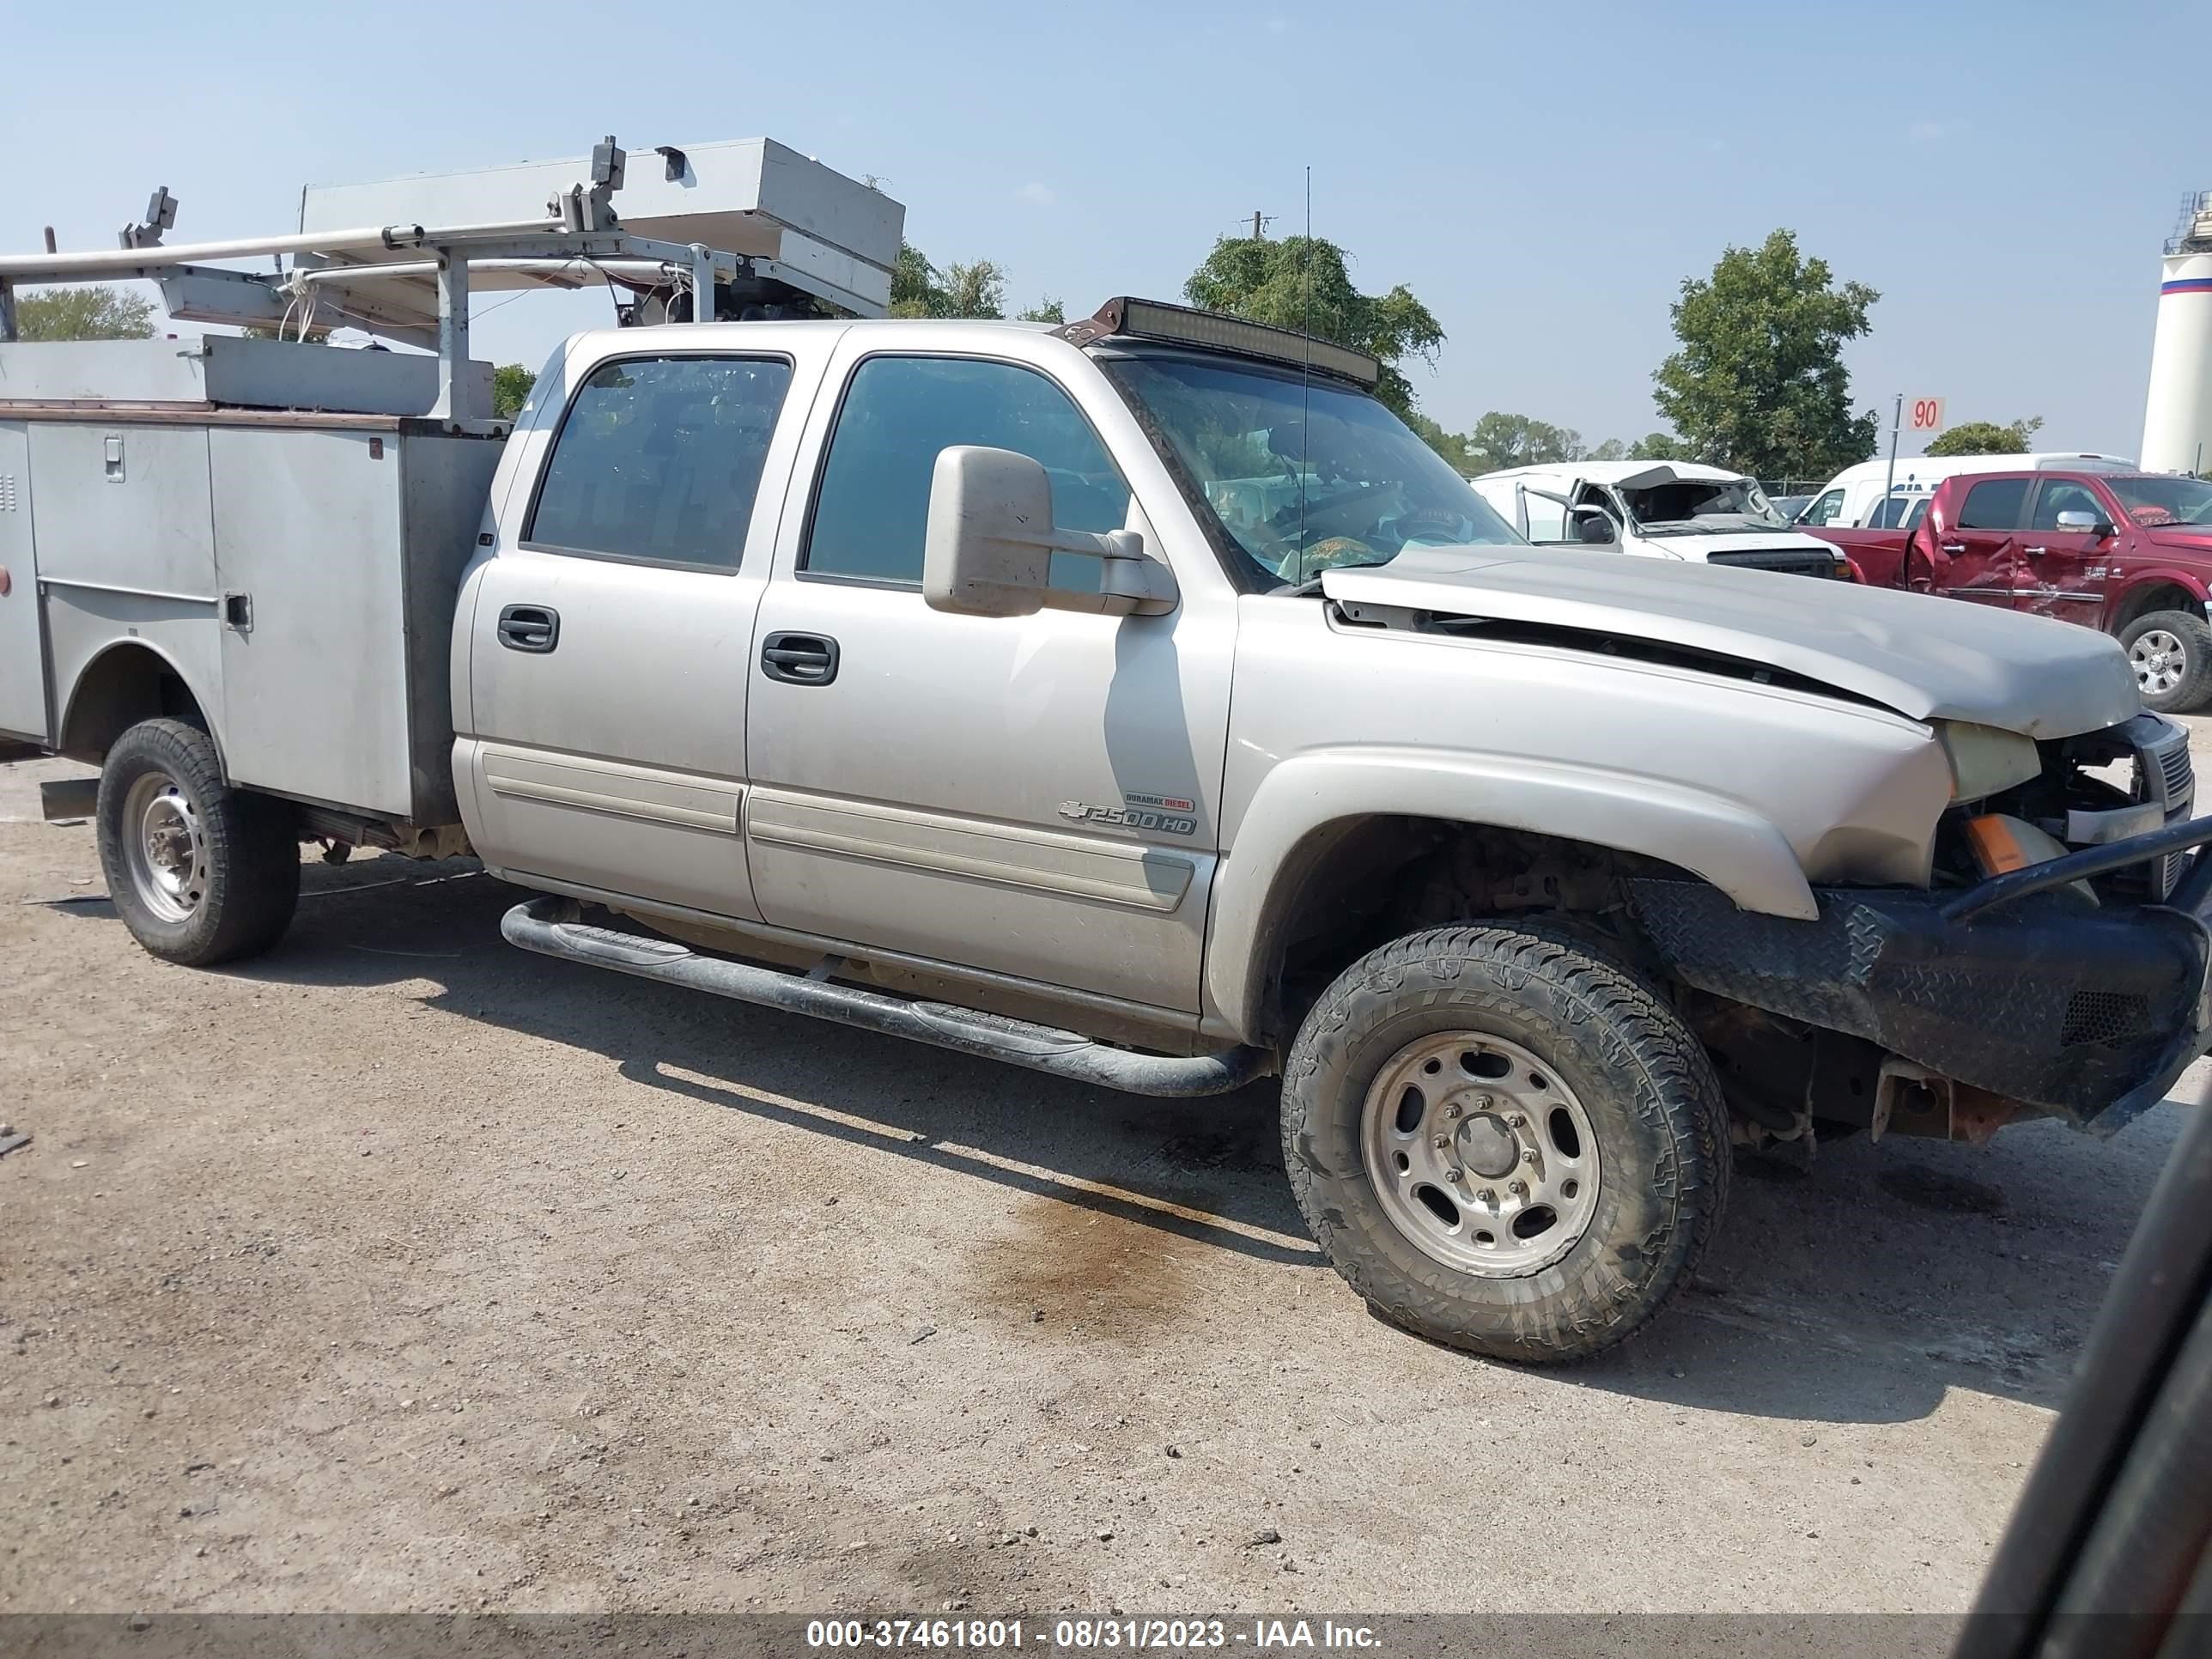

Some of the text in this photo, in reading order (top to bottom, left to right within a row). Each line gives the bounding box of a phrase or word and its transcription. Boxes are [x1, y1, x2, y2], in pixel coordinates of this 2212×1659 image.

[1914, 400, 1937, 428] 90
[1126, 793, 1190, 810] DURAMAX DIESEL
[1091, 807, 1193, 832] 2500 HD
